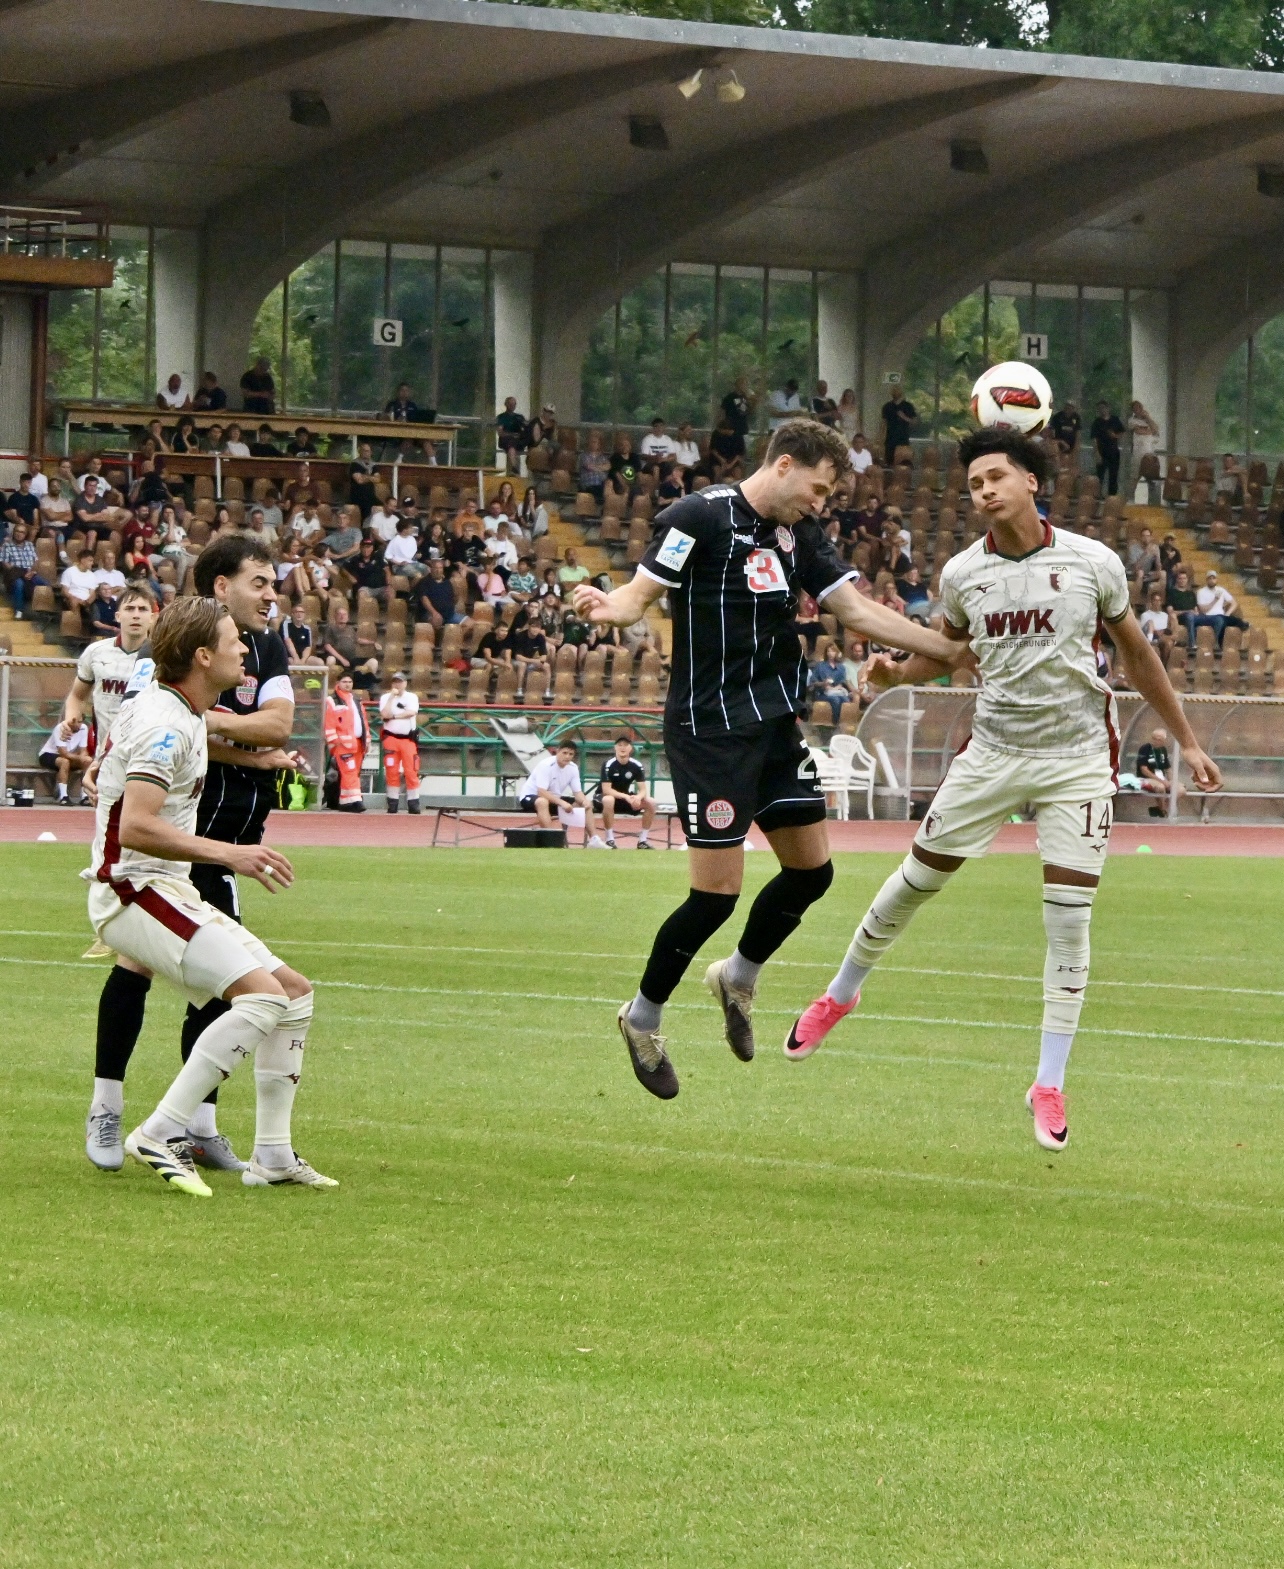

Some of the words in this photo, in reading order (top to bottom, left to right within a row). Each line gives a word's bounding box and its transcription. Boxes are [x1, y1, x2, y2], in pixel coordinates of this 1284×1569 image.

[380, 321, 397, 343] G
[1027, 336, 1042, 356] H
[984, 609, 1056, 638] WWK
[102, 679, 129, 695] WW
[930, 810, 944, 822] FCA
[1079, 801, 1111, 839] 14
[1056, 964, 1089, 973] FCA
